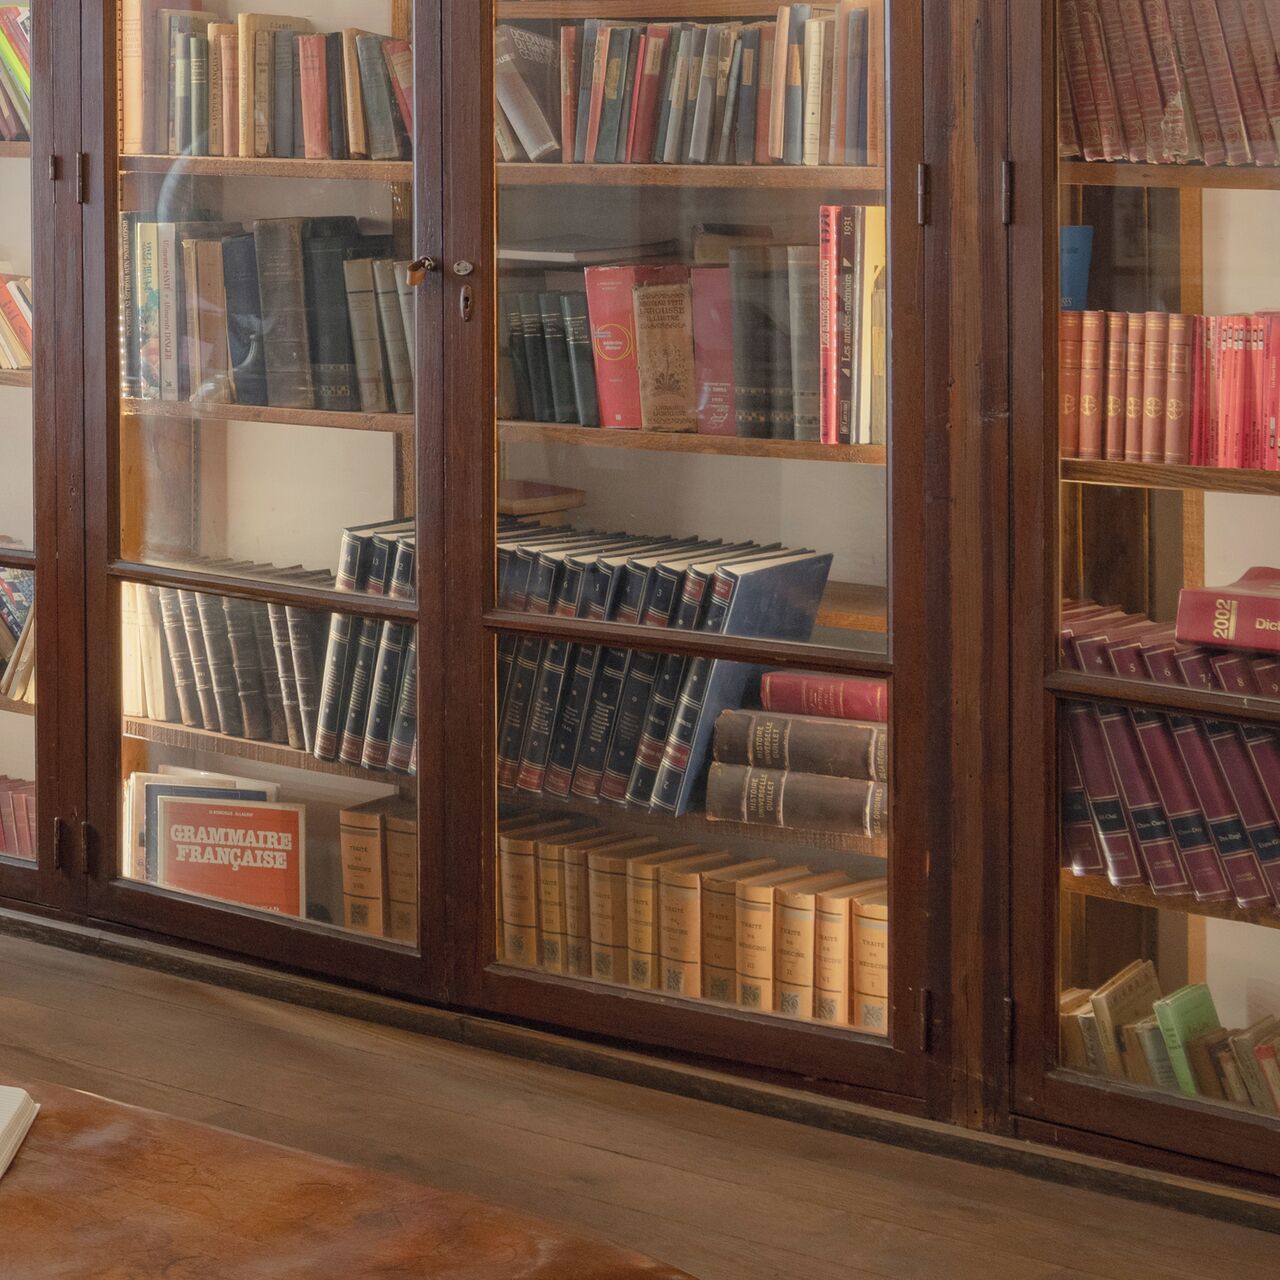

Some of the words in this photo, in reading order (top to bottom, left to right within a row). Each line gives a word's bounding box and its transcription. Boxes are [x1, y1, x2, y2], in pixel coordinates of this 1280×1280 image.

[842, 215, 852, 235] 1931
[840, 273, 852, 344] années-mémoire
[841, 345, 851, 361] Les
[1213, 599, 1231, 640] 2002
[756, 726, 764, 759] HISTOIRE
[750, 778, 759, 812] HISTOIRE
[170, 824, 293, 850] GRAMMAIRE
[175, 844, 288, 871] FRANÇAISE
